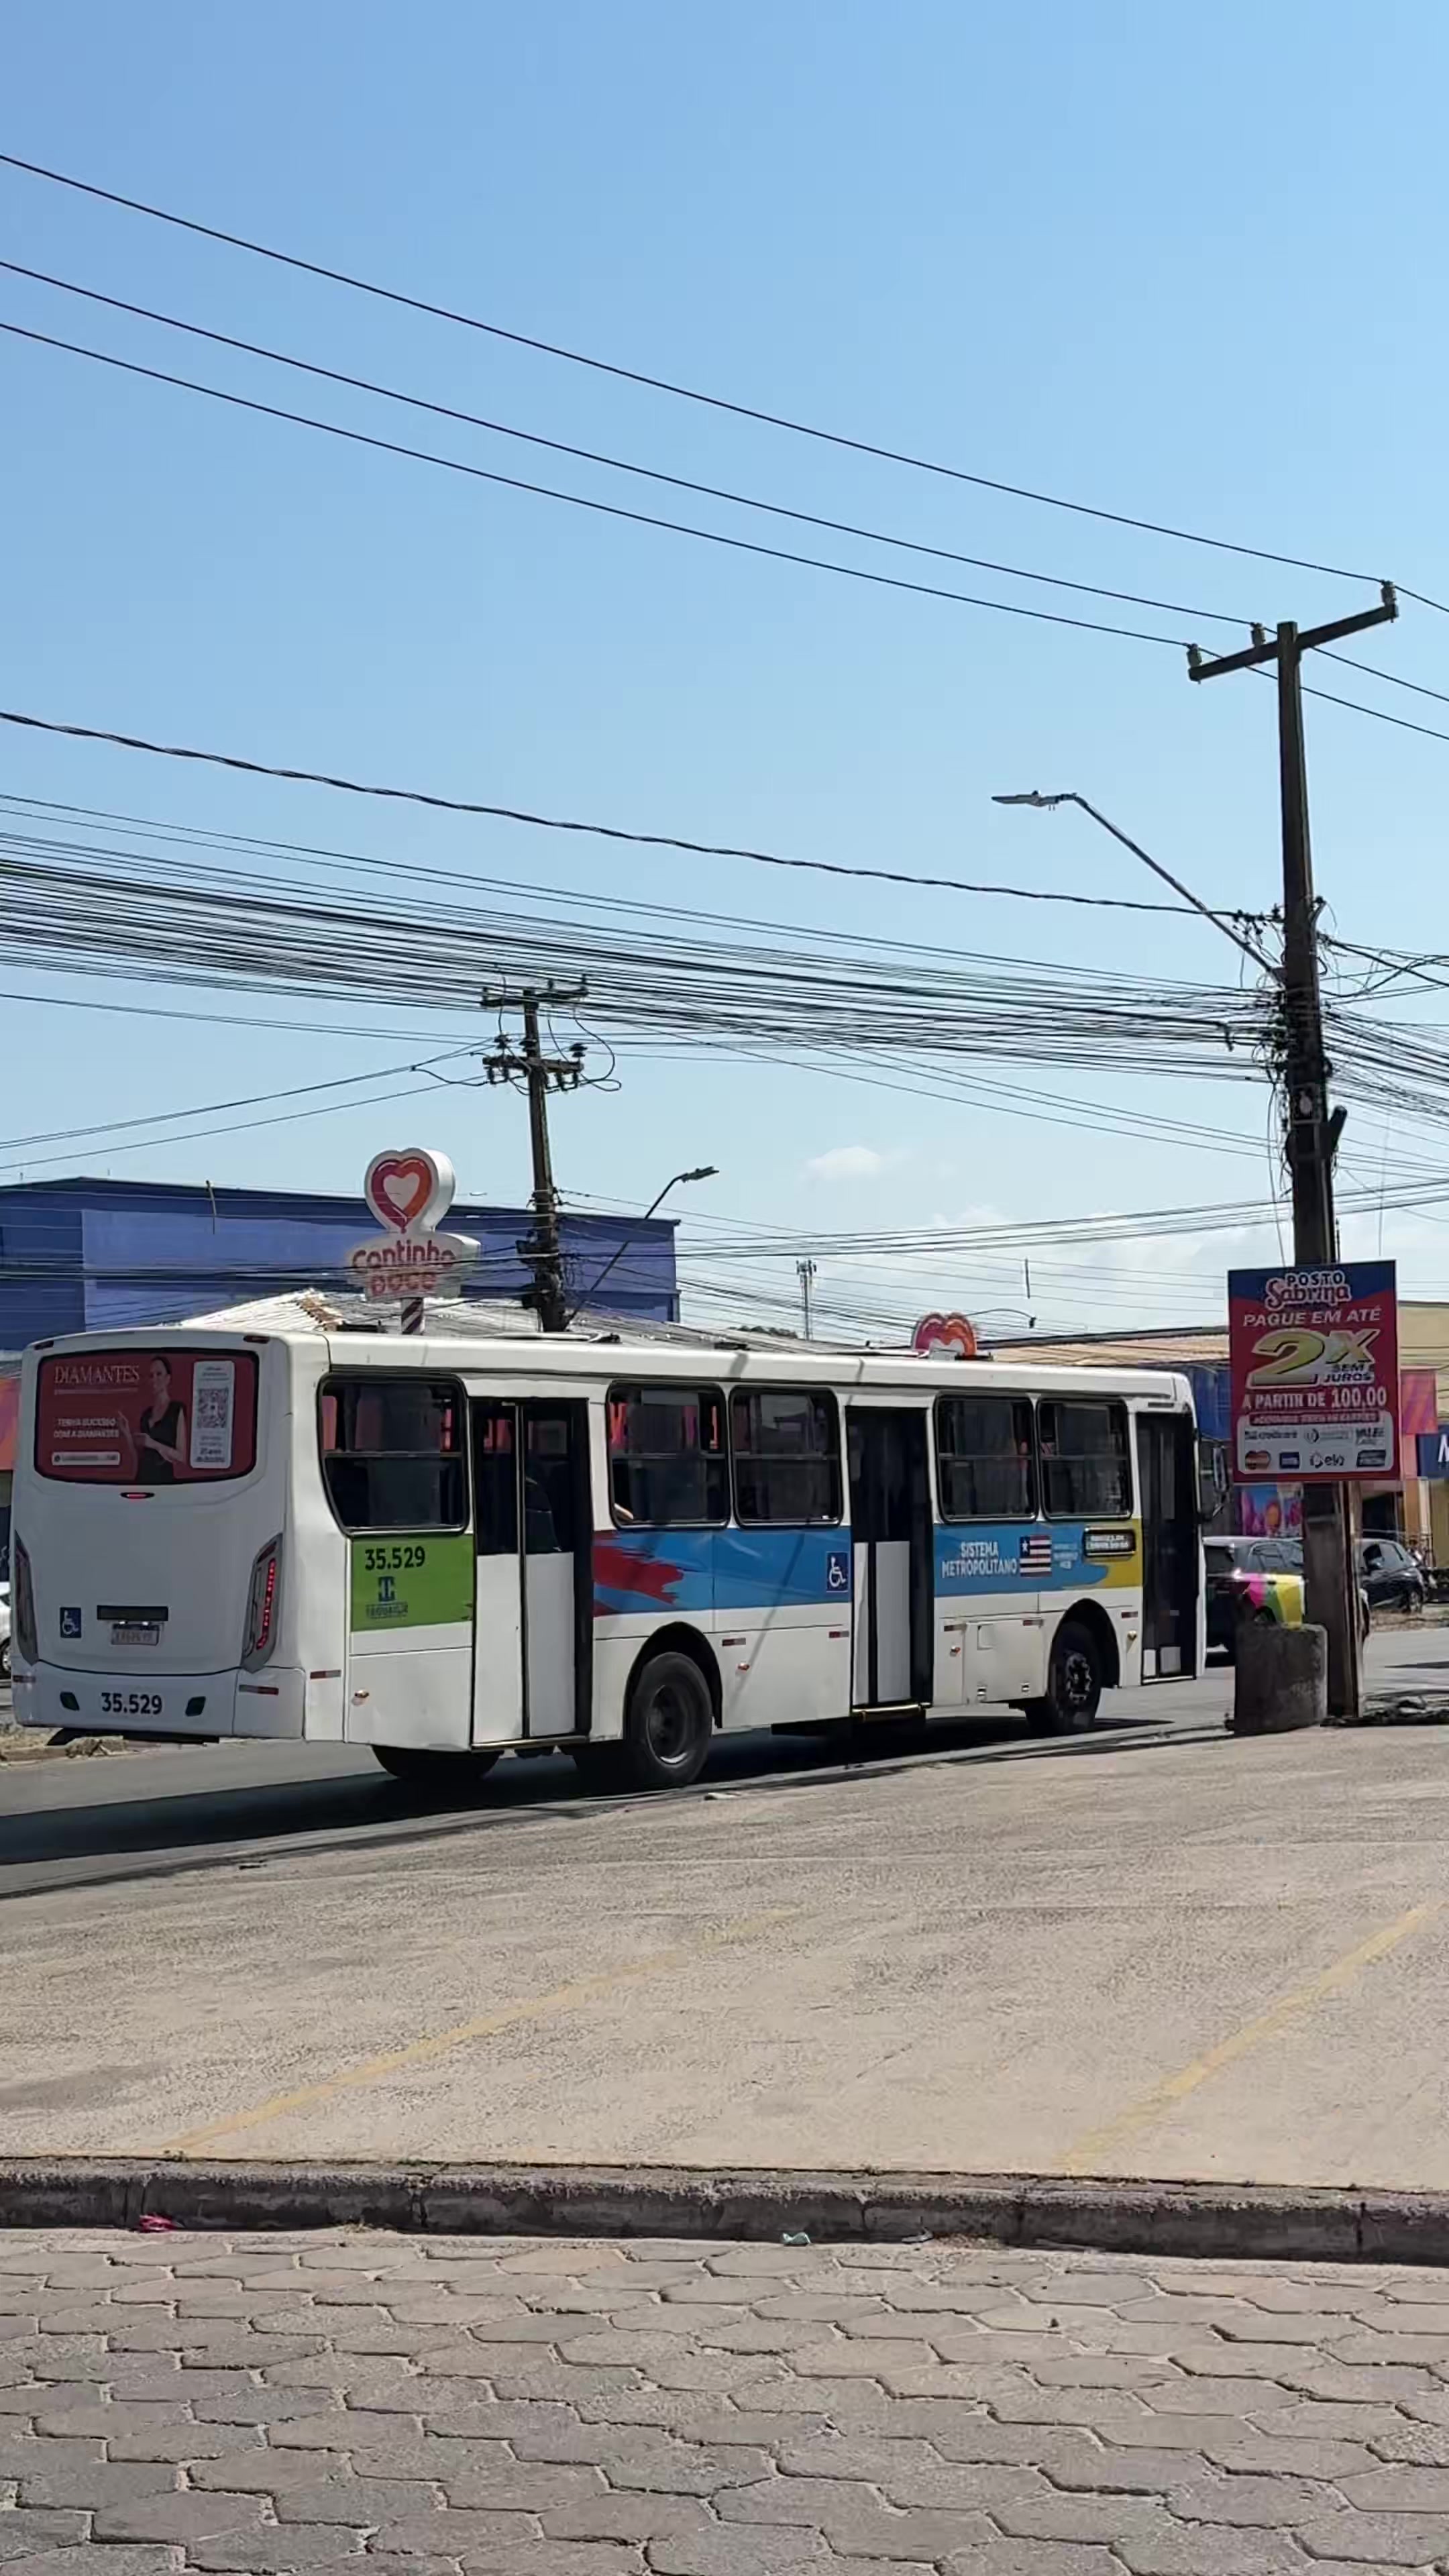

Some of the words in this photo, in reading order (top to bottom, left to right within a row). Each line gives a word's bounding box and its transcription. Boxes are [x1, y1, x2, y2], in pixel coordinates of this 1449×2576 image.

[1287, 1271, 1344, 1287] POSTO
[1266, 1278, 1351, 1309] Sabrina
[1243, 1312, 1307, 1327] PAGUE
[1311, 1310, 1342, 1324] EM
[1346, 1305, 1382, 1322] ATÉ
[54, 1365, 140, 1385] DIAMANTES
[1324, 1373, 1372, 1383] JUROS
[1255, 1393, 1303, 1407] PARTIR
[1308, 1392, 1326, 1407] DE
[364, 1546, 426, 1570] 35.529
[960, 1541, 999, 1558] SISTEMA
[942, 1556, 1019, 1578] METROPOLITANO
[101, 1692, 163, 1715] 35.529
